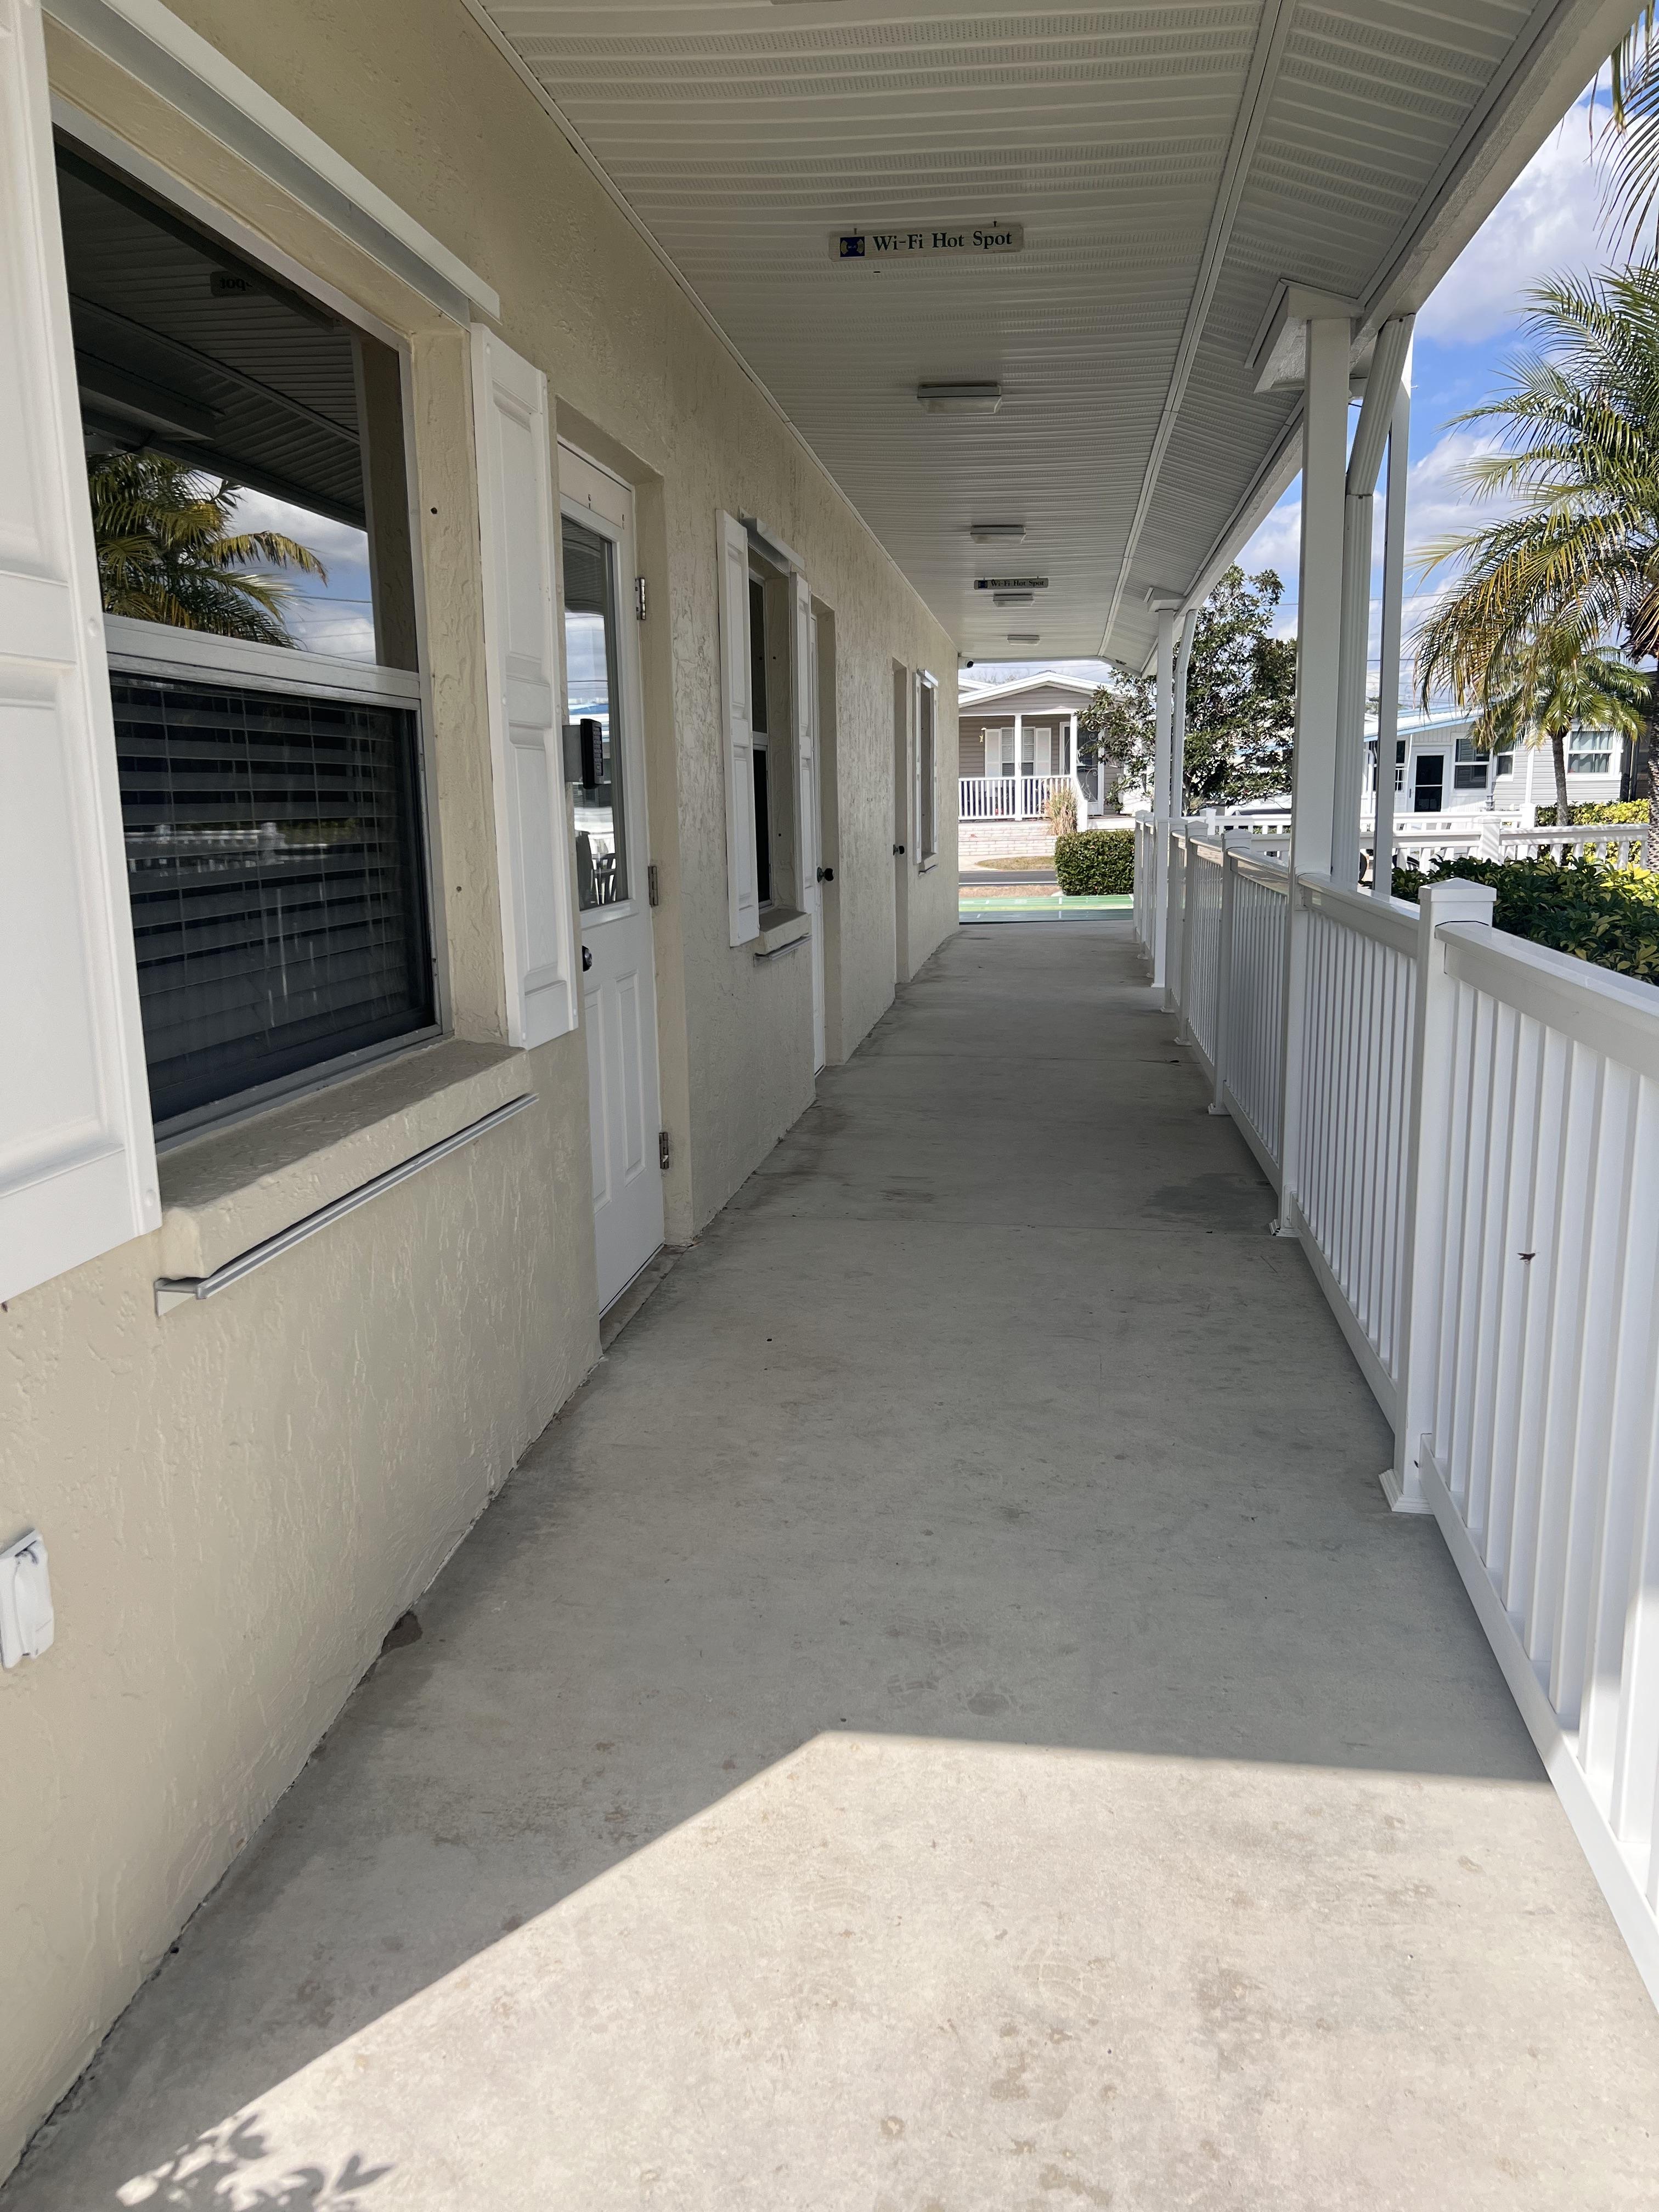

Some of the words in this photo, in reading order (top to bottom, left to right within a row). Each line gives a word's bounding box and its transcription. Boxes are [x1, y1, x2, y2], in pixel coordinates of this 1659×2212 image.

[872, 234, 924, 251] Wi-Fi
[931, 232, 965, 249] Hot
[972, 230, 1013, 250] Spot
